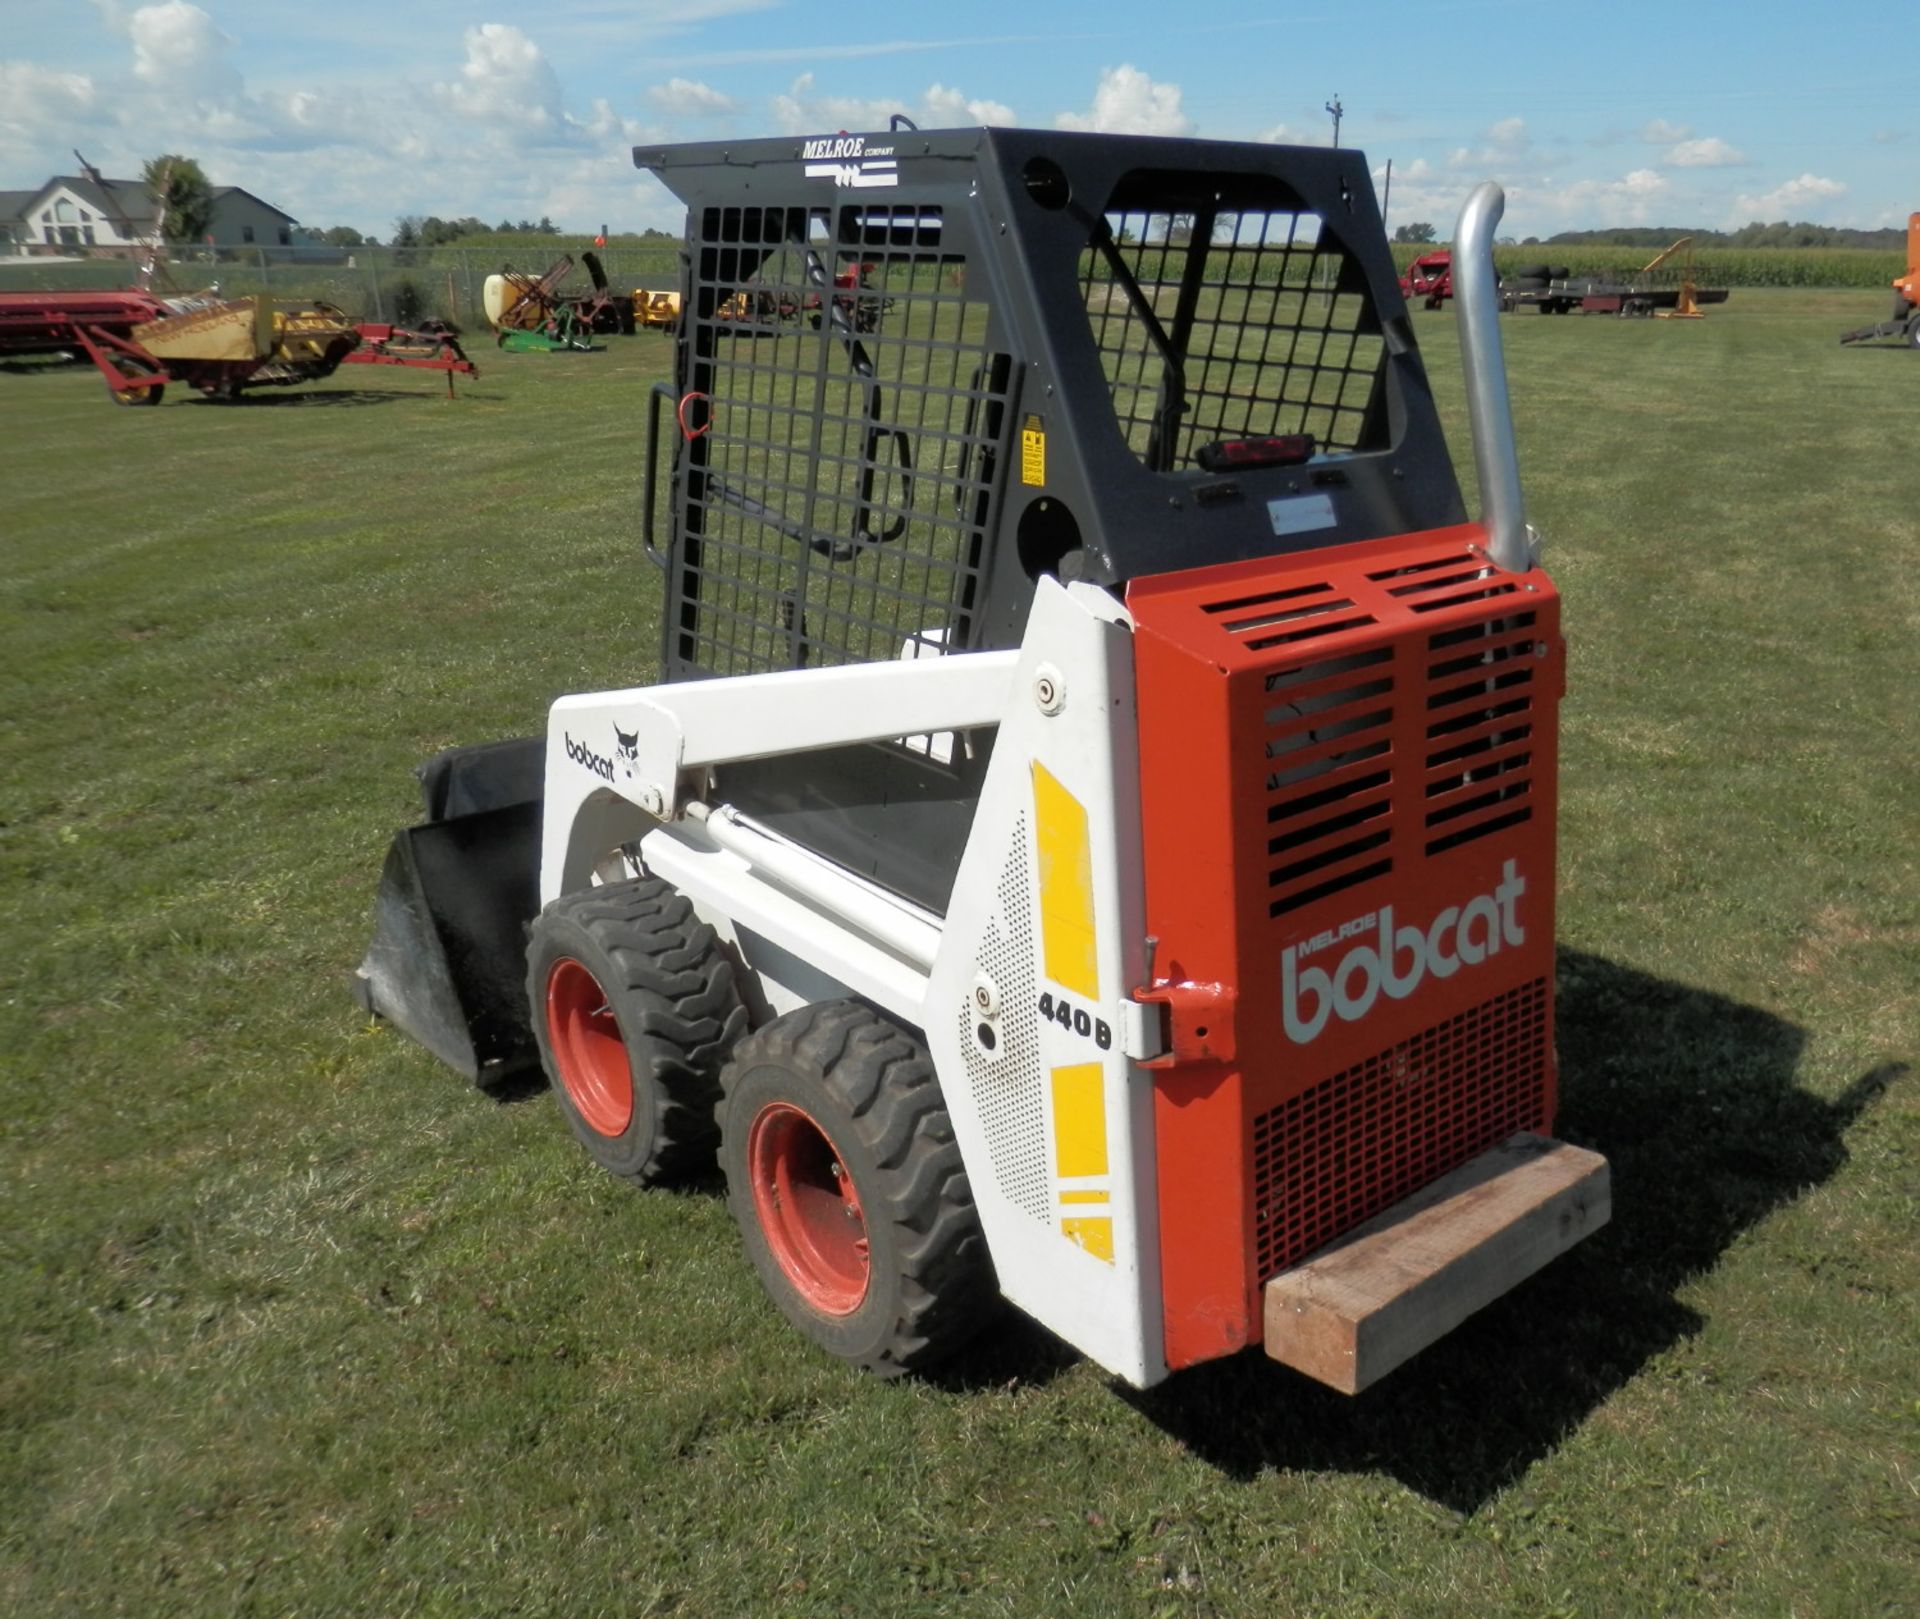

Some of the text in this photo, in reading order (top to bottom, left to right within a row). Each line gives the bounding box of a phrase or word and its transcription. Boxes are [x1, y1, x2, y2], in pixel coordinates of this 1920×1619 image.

[802, 137, 895, 159] MELROE COMPANY
[564, 731, 615, 783] bobcat
[1282, 858, 1525, 1044] bobcat
[1299, 912, 1377, 958] MELROE
[1038, 992, 1112, 1051] 440B
